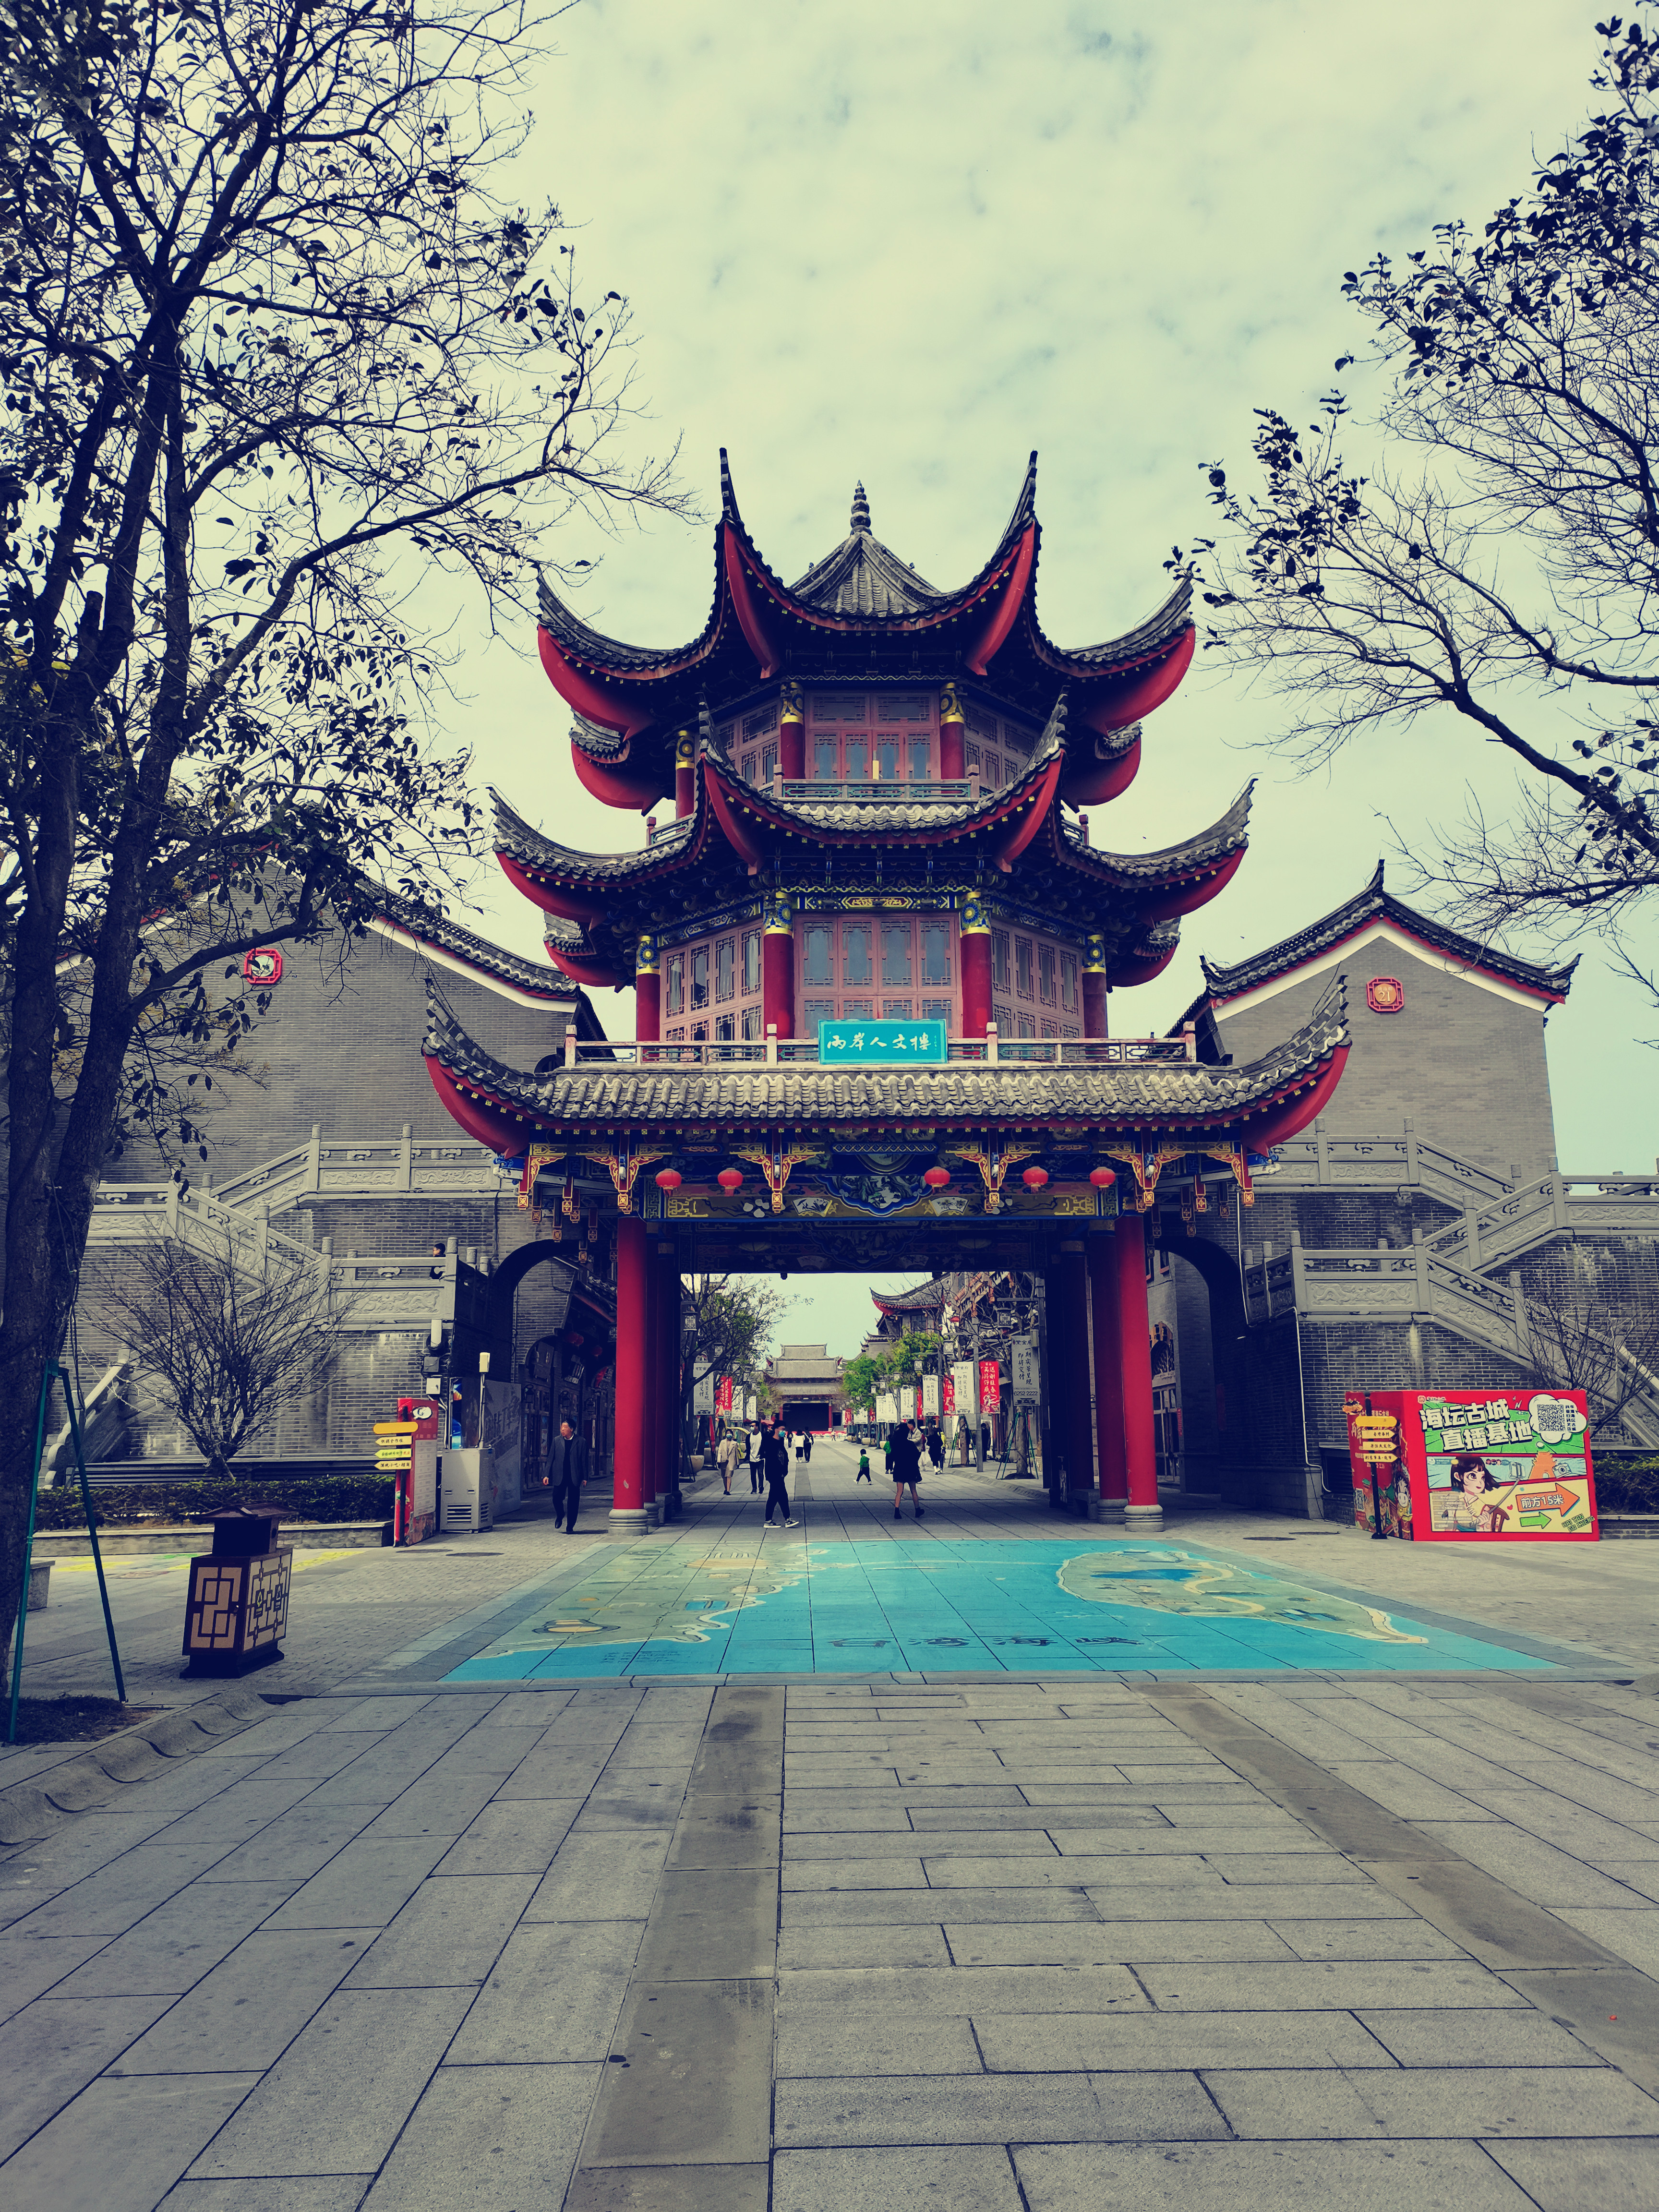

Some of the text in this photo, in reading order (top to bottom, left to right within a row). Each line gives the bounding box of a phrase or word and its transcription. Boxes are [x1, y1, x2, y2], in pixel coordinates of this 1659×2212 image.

[1379, 991, 1390, 1002] 21
[1419, 1398, 1511, 1431] 海坛古城
[1440, 1419, 1533, 1452] 直播基地
[1521, 1494, 1564, 1509] 前方15米
[1561, 1519, 1573, 1528] HAI
